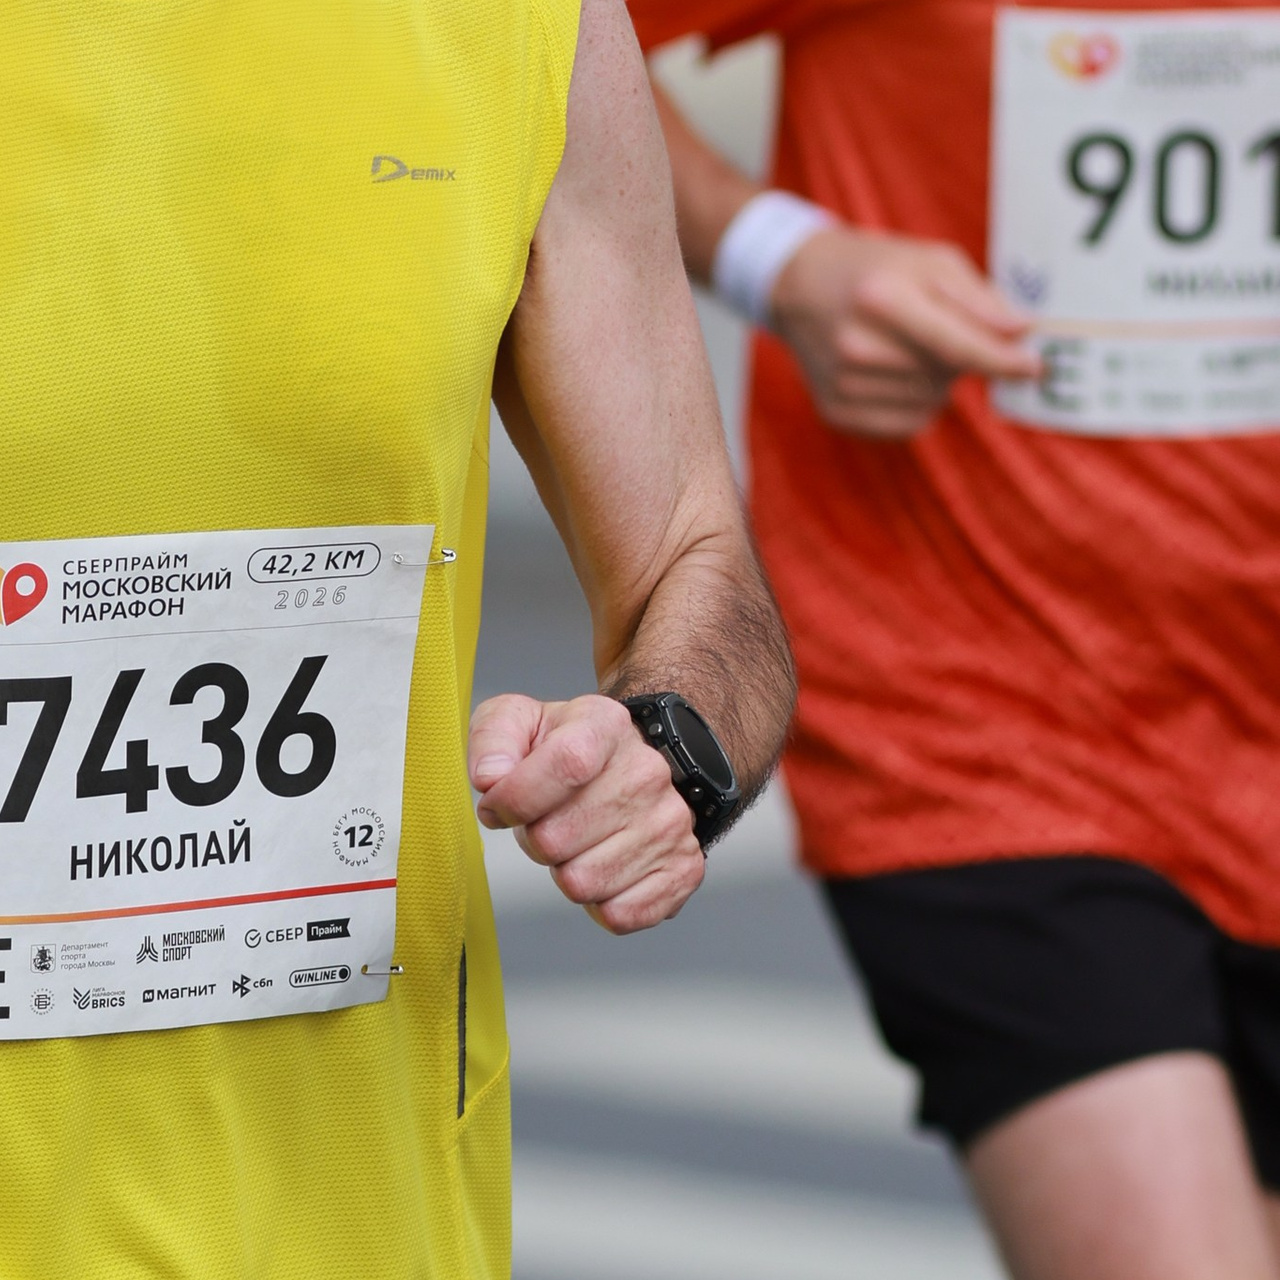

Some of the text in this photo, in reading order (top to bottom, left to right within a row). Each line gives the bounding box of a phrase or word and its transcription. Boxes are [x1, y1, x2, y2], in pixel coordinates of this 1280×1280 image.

[63, 551, 188, 575] СБЕРПРАЙМ
[262, 553, 316, 576] 42,2
[62, 567, 232, 600] МОСКОВСКИЙ
[274, 586, 347, 609] 2026
[62, 597, 185, 624] МАРАФОН
[344, 824, 373, 848] 12
[70, 818, 251, 881] НИКОЛАЙ
[163, 924, 225, 947] МОСКОВСКИЙ
[265, 924, 342, 942] СБЕР Прайм
[61, 942, 109, 952] Департамент
[162, 946, 192, 962] СПОРТ
[61, 953, 86, 962] спорта
[61, 960, 116, 970] города Москвы
[253, 978, 273, 988] сбп
[294, 969, 337, 984] WINLINE
[91, 996, 125, 1009] BRICS
